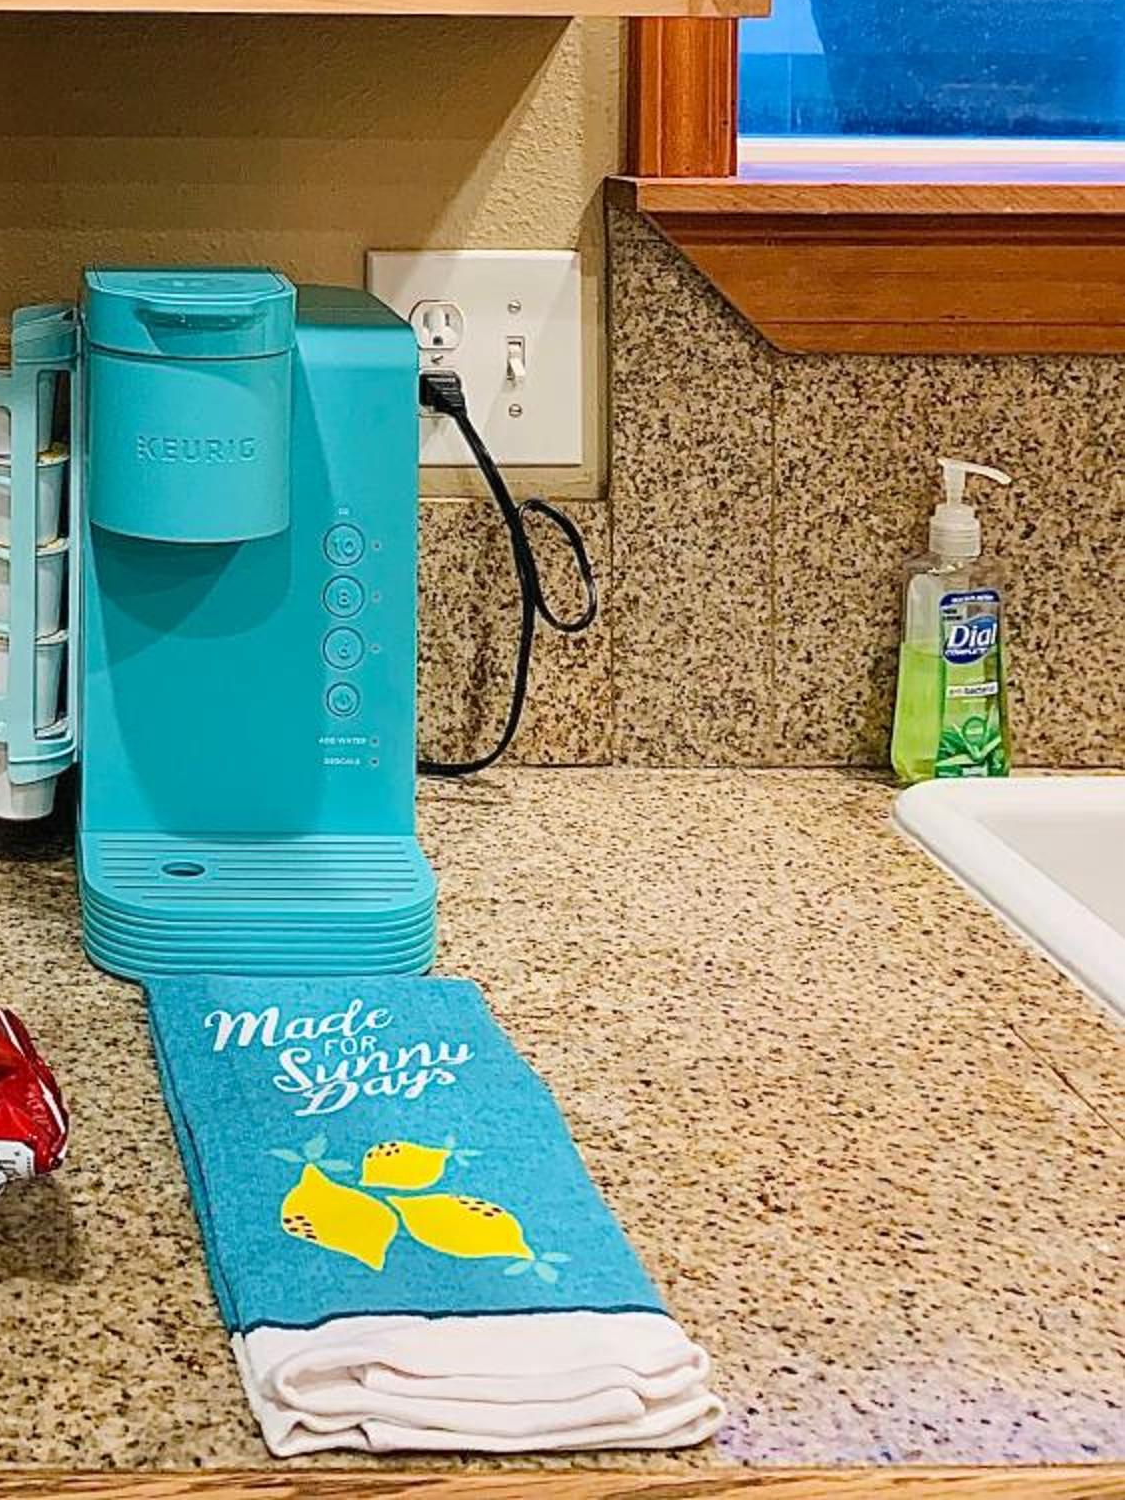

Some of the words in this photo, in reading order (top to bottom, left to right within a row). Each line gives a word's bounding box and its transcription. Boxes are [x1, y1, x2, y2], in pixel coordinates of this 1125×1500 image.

[137, 435, 257, 462] KEURIG
[947, 623, 997, 648] Dial
[203, 999, 394, 1052] Made
[324, 1034, 376, 1057] FOR
[273, 1039, 475, 1094] Sunny
[294, 1066, 458, 1117] Days
